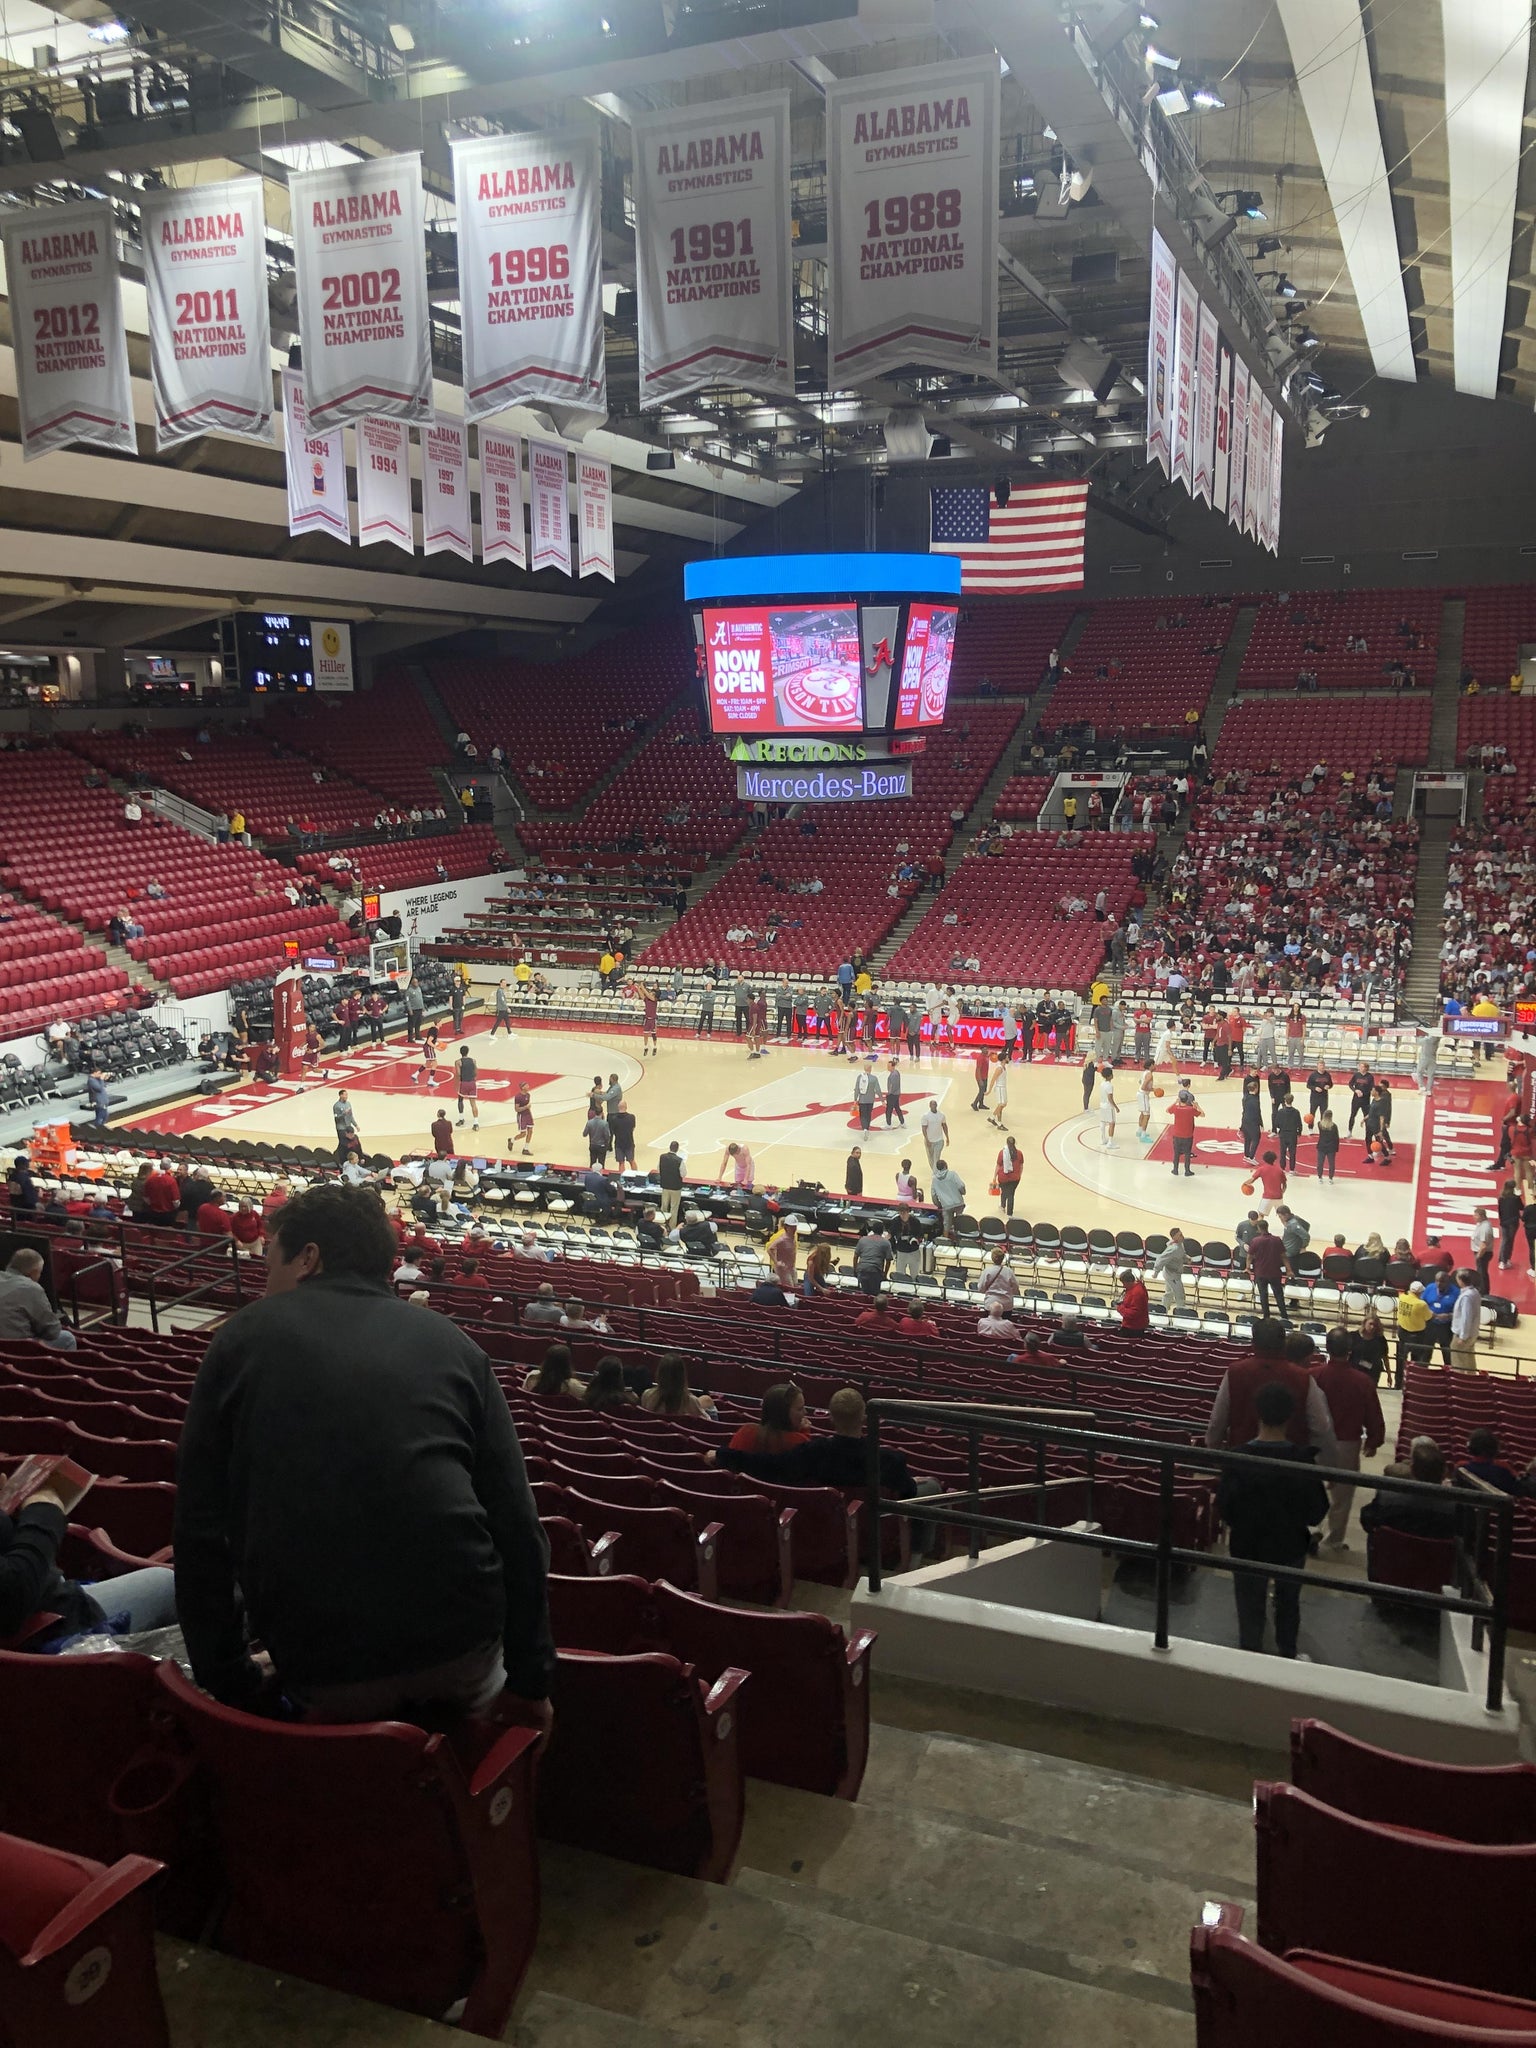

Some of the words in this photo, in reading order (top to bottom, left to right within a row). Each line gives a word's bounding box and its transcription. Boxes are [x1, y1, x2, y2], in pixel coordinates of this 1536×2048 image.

[853, 96, 970, 145] ALABAMA
[657, 131, 764, 175] ALABAMA
[864, 136, 958, 163] GYMNASTICS
[478, 161, 576, 201] ALABAMA
[667, 168, 753, 193] GYMNASTICS
[313, 189, 402, 228] ALABAMA
[488, 196, 567, 218] GYMNASTICS
[863, 188, 961, 238] 1988
[162, 212, 244, 246] ALABAMA
[323, 224, 393, 244] GYMNASTICS
[22, 230, 98, 265] ALABAMA
[171, 244, 236, 262] GYMNASTICS
[669, 220, 753, 263] 1991
[861, 232, 964, 263] NATIONAL
[31, 262, 92, 280] GYMNASTICS
[488, 244, 570, 287] 1996
[666, 259, 760, 287] NATIONAL
[860, 253, 964, 281] CHAMPIONS
[322, 268, 401, 311] 2002
[487, 283, 574, 308] NATIONAL
[667, 279, 761, 305] CHAMPIONS
[176, 288, 239, 325] 2011
[487, 302, 575, 325] CHAMPIONS
[33, 303, 100, 340] 2012
[324, 307, 403, 330] NATIONAL
[173, 325, 245, 345] NATIONAL
[325, 325, 404, 347] CHAMPIONS
[35, 339, 104, 359] NATIONAL
[174, 343, 246, 361] CHAMPIONS
[35, 355, 105, 374] CHAMPIONS
[304, 438, 330, 457] 1994
[428, 426, 461, 446] ALABAMA
[485, 440, 515, 460] ALABAMA
[371, 454, 398, 475] 1994
[535, 453, 563, 472] ALABAMA
[582, 465, 606, 483] ALABAMA
[438, 469, 454, 482] 1997
[439, 482, 455, 496] 1998
[1343, 563, 1351, 574] R
[319, 659, 346, 673] Hiller
[714, 649, 760, 672] NOW
[905, 645, 924, 668] NOW
[714, 671, 765, 694] OPEN
[901, 667, 921, 689] OPEN
[756, 740, 867, 762] REGIONS
[744, 771, 906, 798] Mercedes-Benz
[405, 894, 428, 908] WHERE
[429, 890, 458, 903] LEGENDS
[406, 908, 419, 917] ARE
[420, 903, 439, 915] MADE
[292, 1022, 306, 1033] YETI
[1426, 1108, 1500, 1239] ALABAMA
